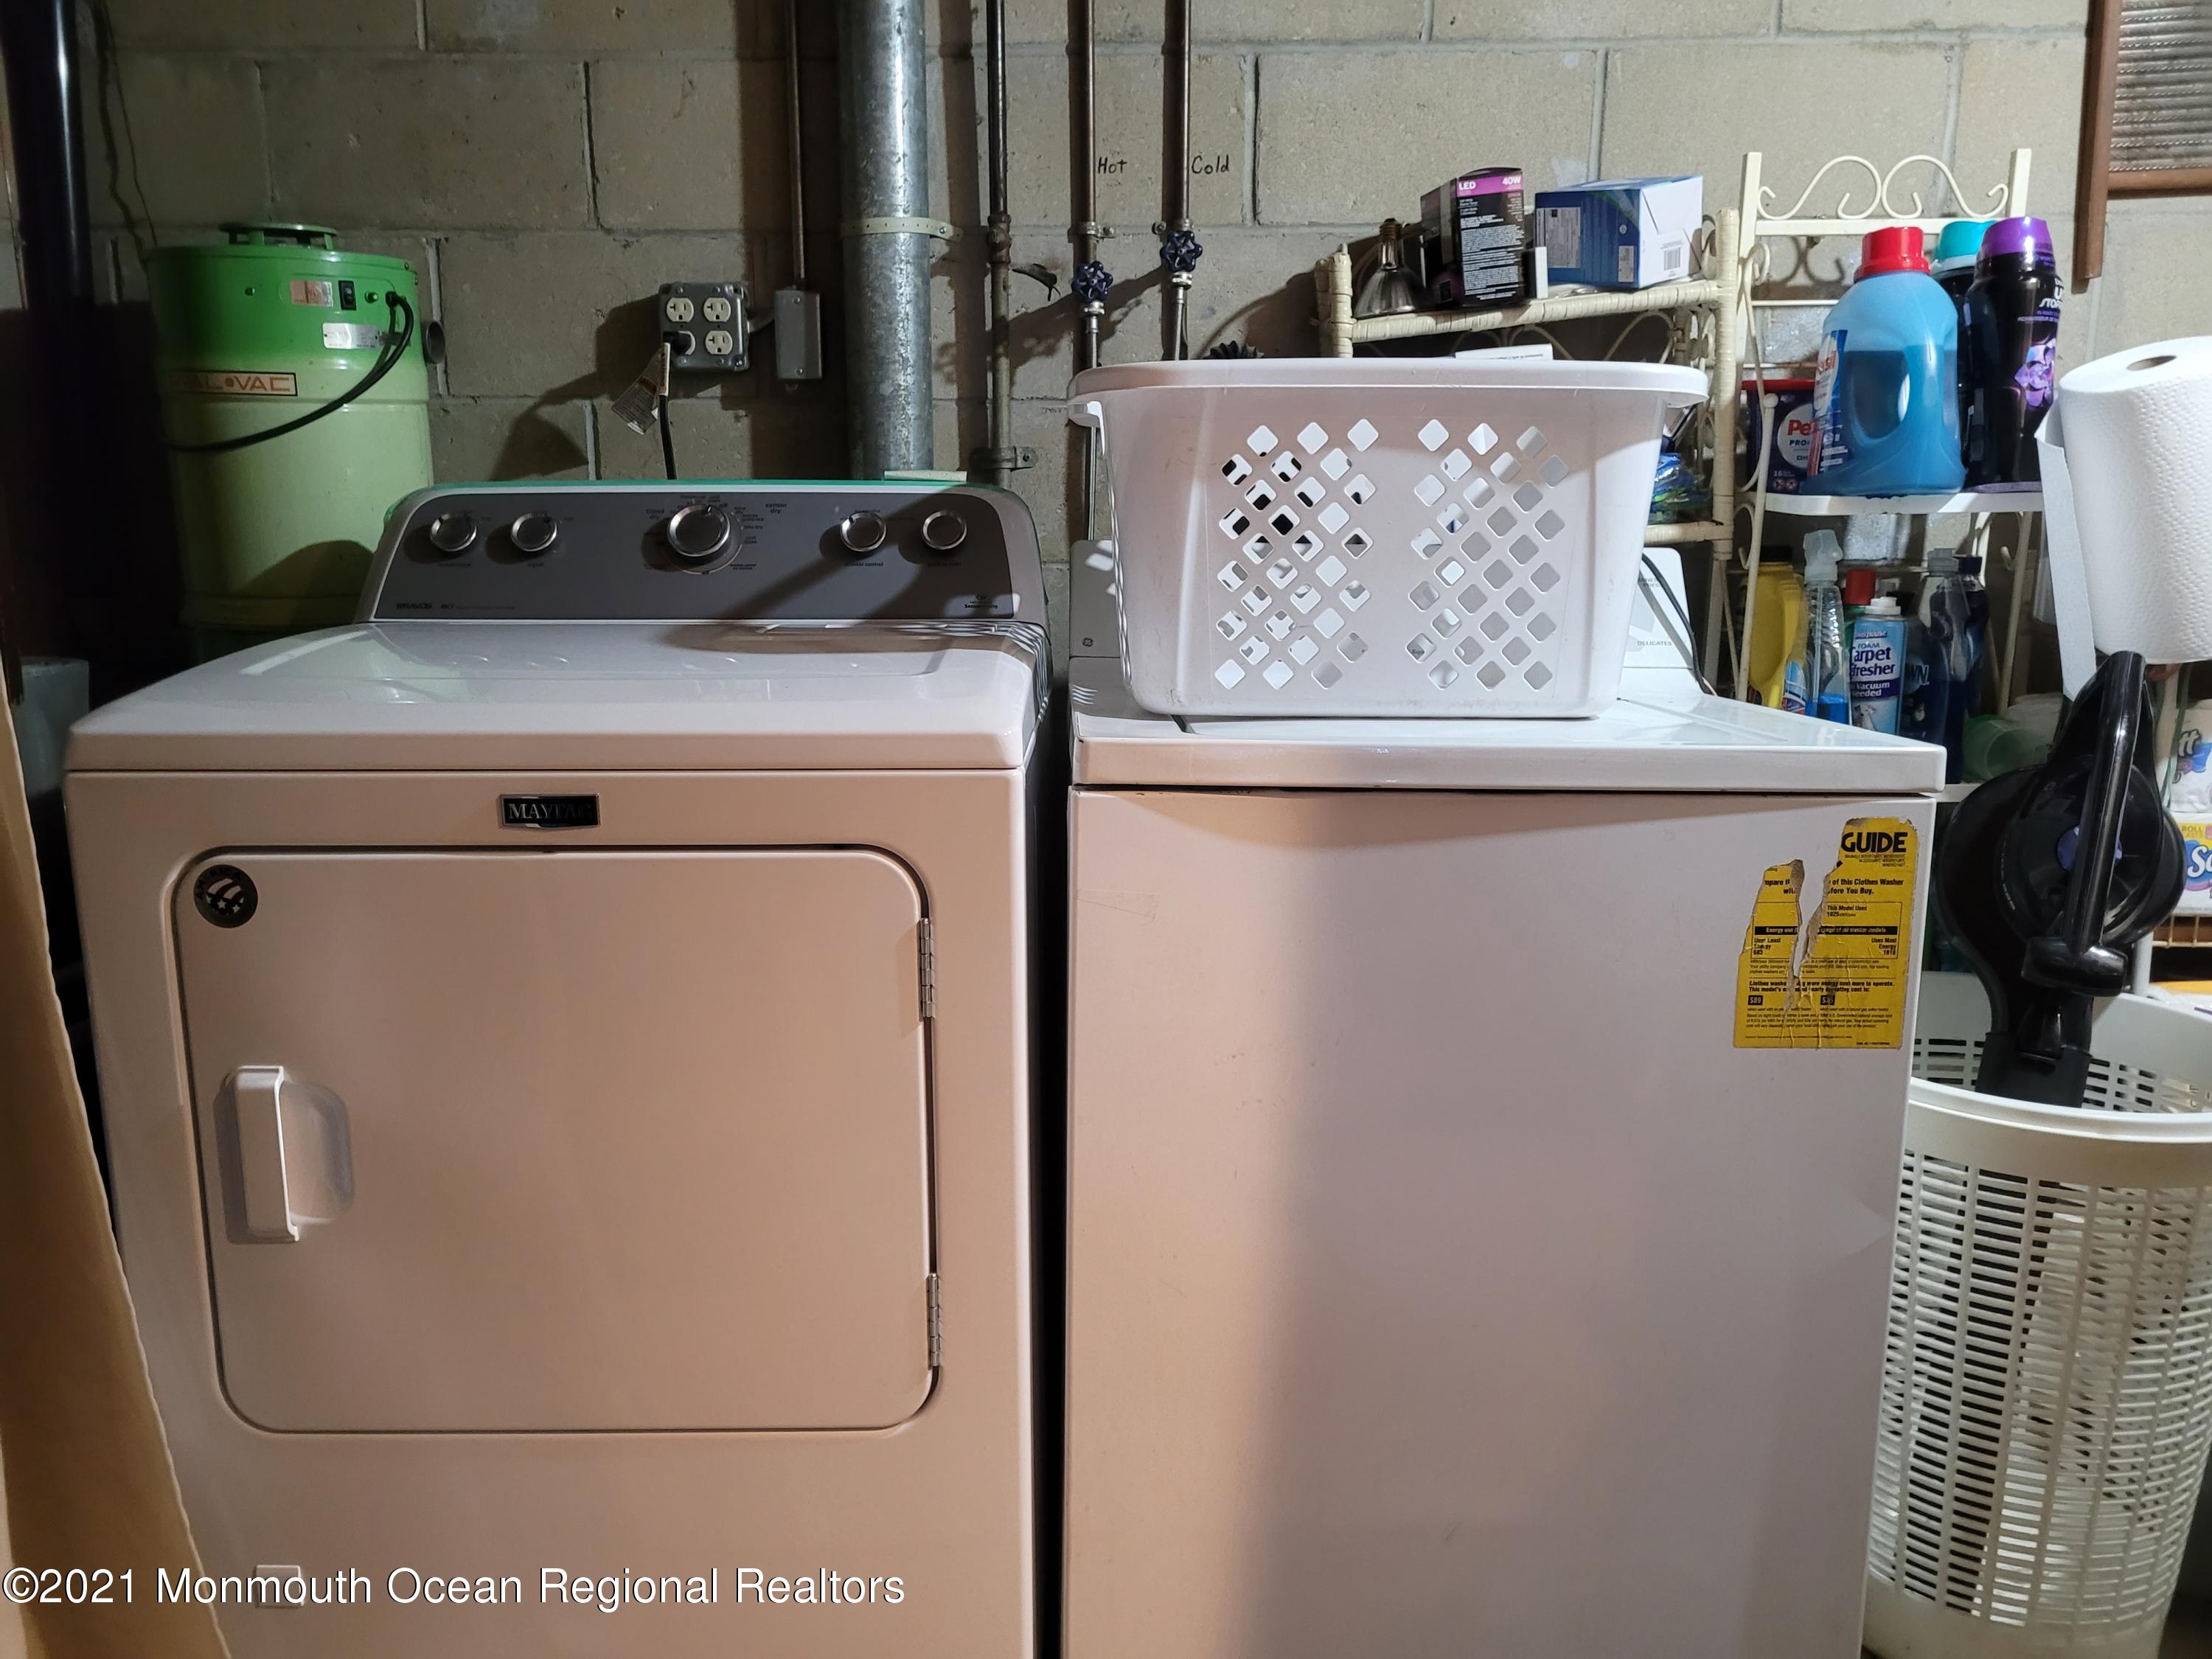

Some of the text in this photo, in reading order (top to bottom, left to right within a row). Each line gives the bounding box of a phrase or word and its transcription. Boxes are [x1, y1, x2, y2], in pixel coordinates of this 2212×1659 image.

[1098, 156, 1127, 174] Hot
[1192, 155, 1229, 174] Cold
[1458, 181, 1476, 190] LED
[1502, 175, 1522, 185] 40W
[1841, 832, 1908, 852] GUIDE
